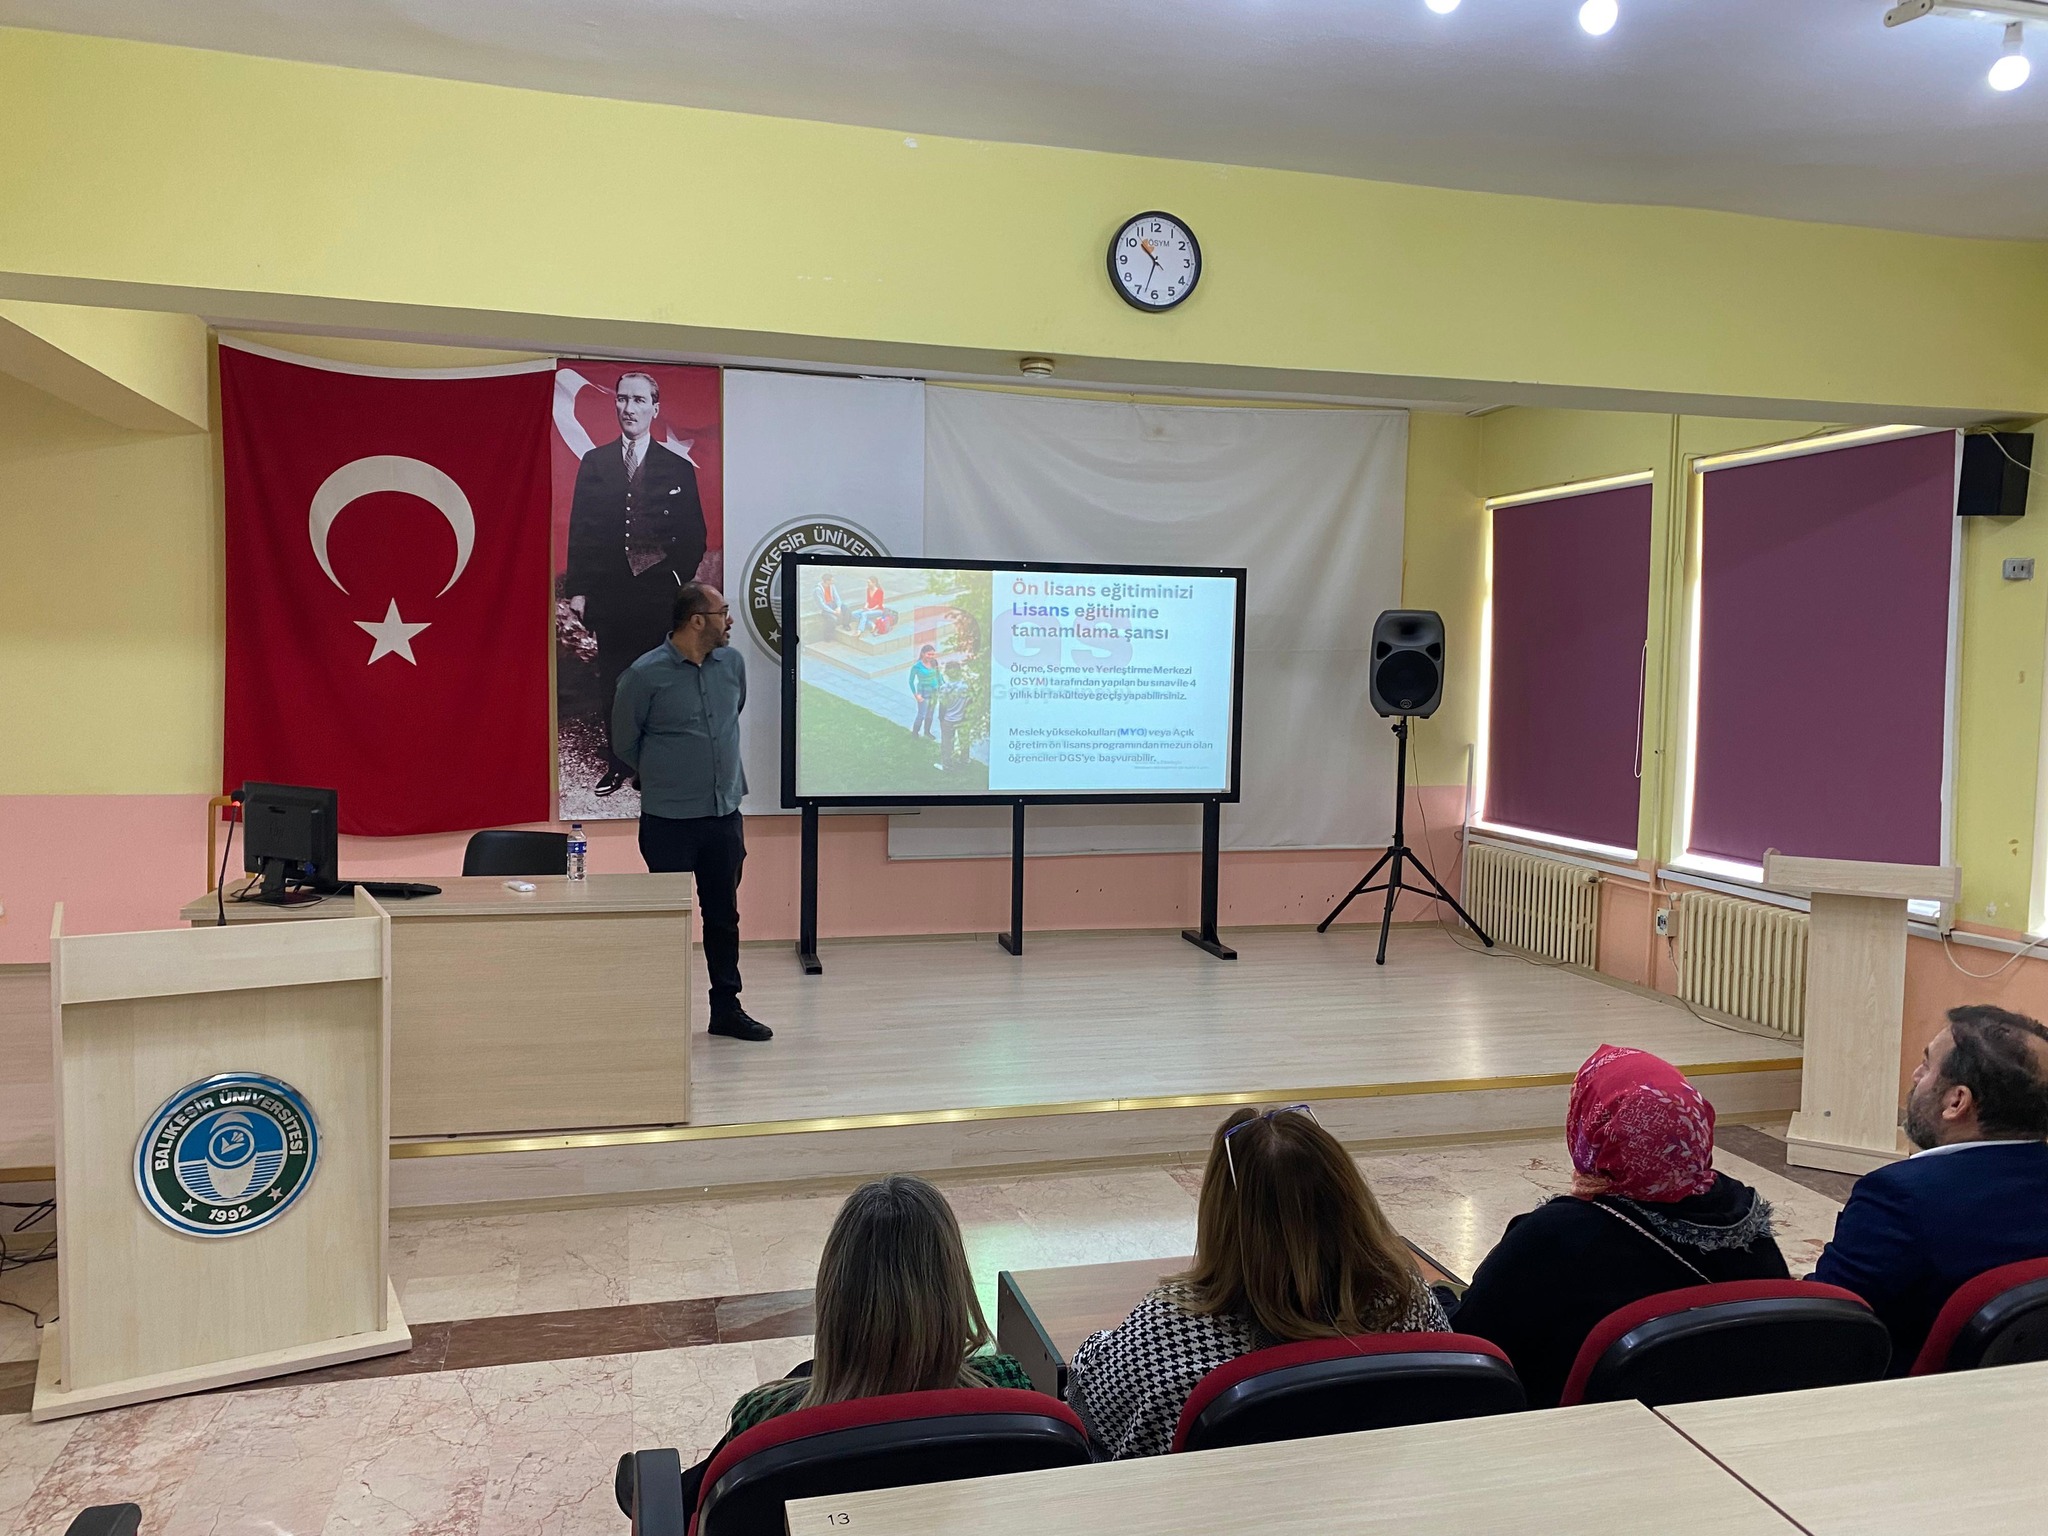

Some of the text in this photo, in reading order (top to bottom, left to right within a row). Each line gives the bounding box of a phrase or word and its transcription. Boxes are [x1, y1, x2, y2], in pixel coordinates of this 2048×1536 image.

[1136, 226, 1144, 237] 11
[1150, 223, 1162, 233] 12
[1126, 237, 1137, 248] 10
[1178, 241, 1186, 251] 2
[1120, 255, 1128, 265] 9
[1183, 259, 1191, 269] 3
[1124, 272, 1132, 282] 8
[1178, 275, 1186, 286] 4
[1134, 284, 1142, 294] 7
[1168, 286, 1175, 296] 5
[1150, 290, 1159, 300] 6
[755, 531, 806, 608] BALIKESİR
[1012, 578, 1193, 600] Ön lisans eğitiminizi
[1013, 602, 1159, 620] Lisans eğitimine
[1011, 624, 1168, 641] tamamlama şansı
[1010, 662, 1045, 674] Ölçme,
[1047, 664, 1080, 674] Seçme
[1096, 665, 1152, 675] Yerleştirme
[1153, 666, 1192, 674] Merkezi
[1050, 677, 1100, 686] tarafından
[1102, 678, 1135, 687] yapılan
[1150, 679, 1176, 687] sınav
[1176, 679, 1189, 687] ile
[1190, 679, 1197, 687] 4
[1010, 690, 1032, 700] yıllık
[1034, 690, 1047, 699] bir
[1096, 691, 1121, 700] geçiş
[1009, 728, 1045, 736] Meslek
[1117, 728, 1147, 737] (MYO)
[1149, 729, 1171, 737] veya
[1173, 728, 1194, 737] Açık
[1009, 741, 1047, 750] öğretim
[1049, 741, 1061, 749] ön
[1063, 741, 1091, 749] lisans
[1092, 741, 1159, 750] programından
[1193, 741, 1213, 749] olan
[1008, 754, 1058, 763] öğrenciler
[1099, 753, 1157, 763] başvurabilir.
[155, 1089, 306, 1170] BALIKESİR ÜNİVERSİTESİ
[208, 1204, 251, 1222] 1992
[827, 1513, 850, 1525] 13
